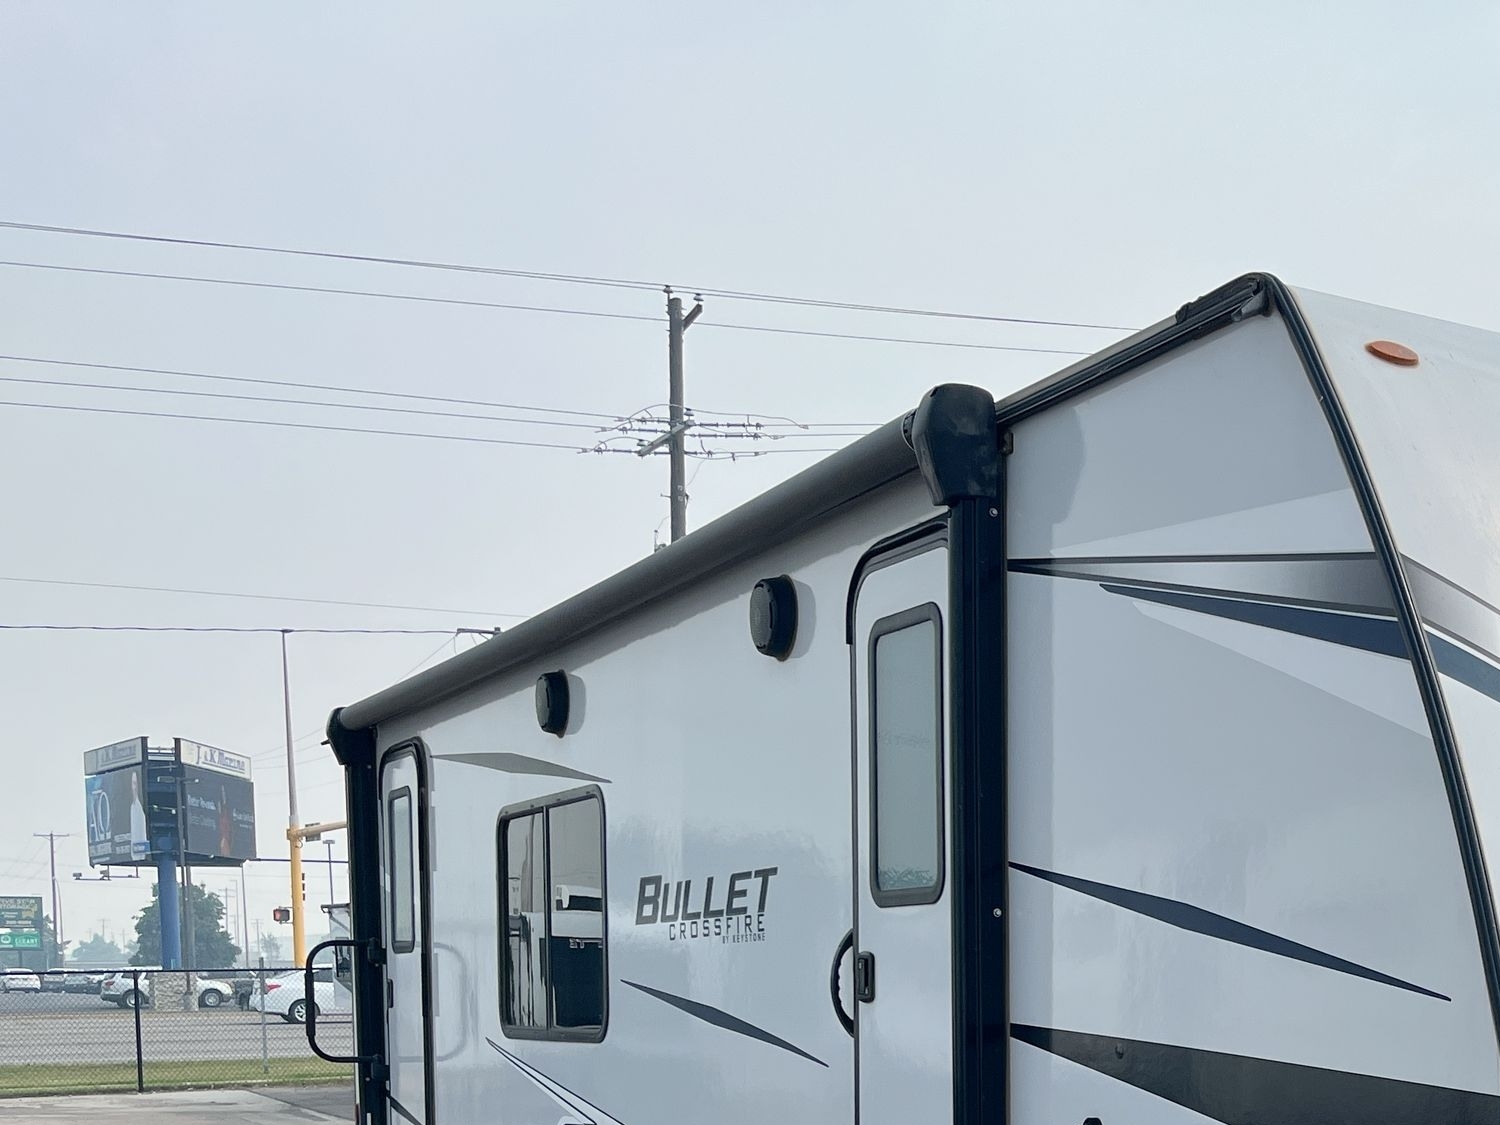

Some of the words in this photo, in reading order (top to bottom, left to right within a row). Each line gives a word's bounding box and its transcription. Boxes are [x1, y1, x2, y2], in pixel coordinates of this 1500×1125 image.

[635, 866, 778, 925] BULLET
[669, 914, 765, 941] CROSSFIRE
[722, 935, 730, 944] BY
[732, 932, 766, 944] KEYSTONE
